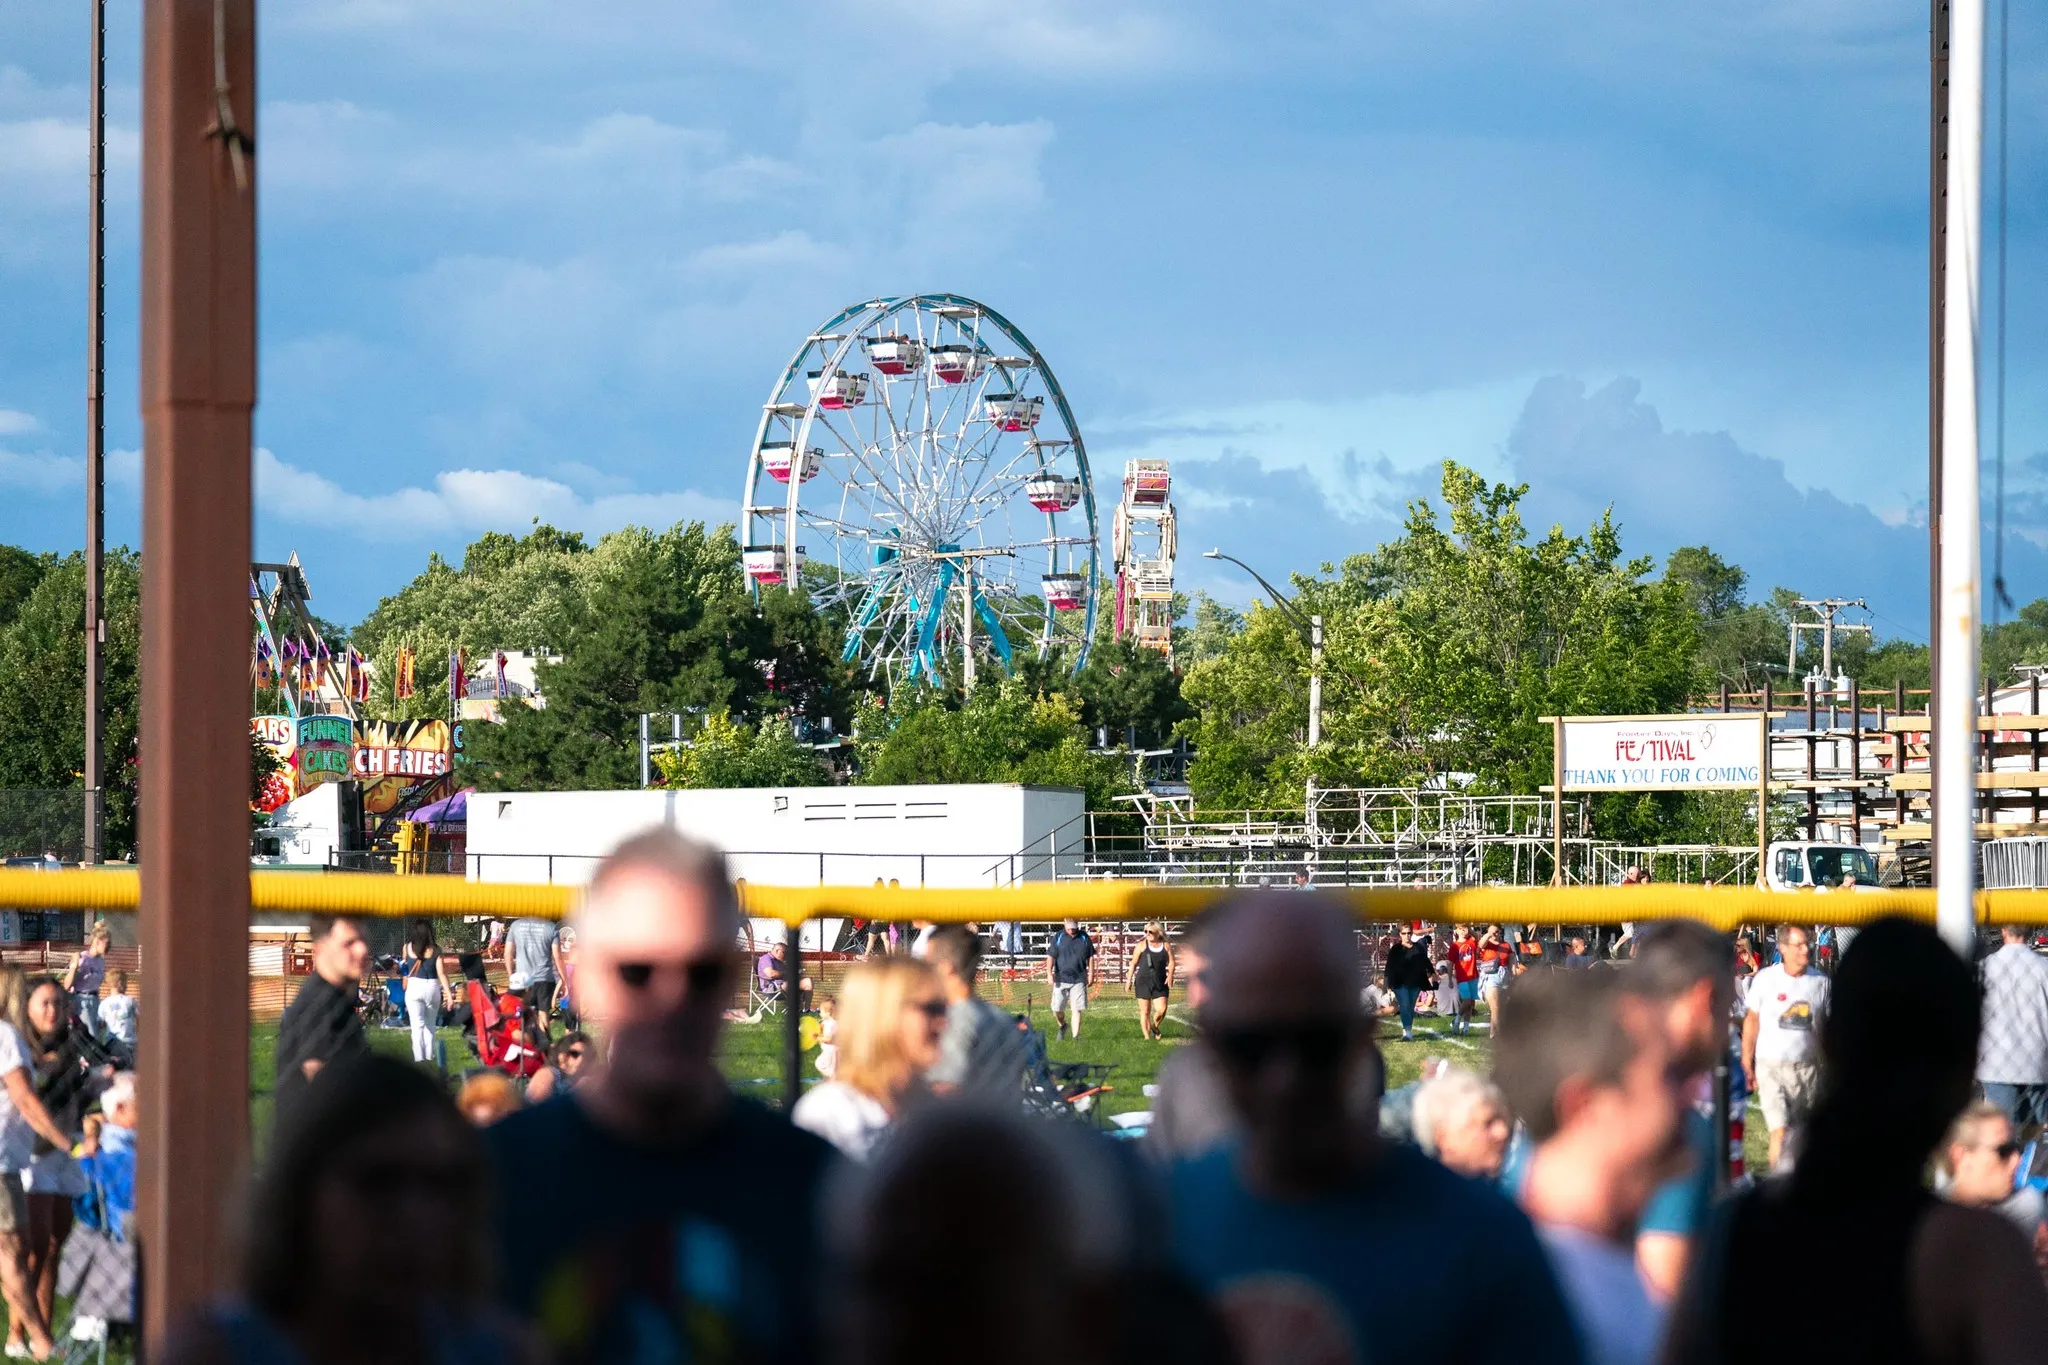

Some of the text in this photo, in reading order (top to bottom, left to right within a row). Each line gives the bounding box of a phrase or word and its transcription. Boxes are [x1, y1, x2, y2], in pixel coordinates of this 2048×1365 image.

[255, 719, 289, 743] ARS
[300, 719, 352, 746] FUNNEL
[304, 750, 347, 773] CAKES
[1616, 739, 1696, 762] FESTIVAL
[387, 749, 447, 776] FRIES
[1563, 766, 1759, 784] THANK YOU FOR COMING
